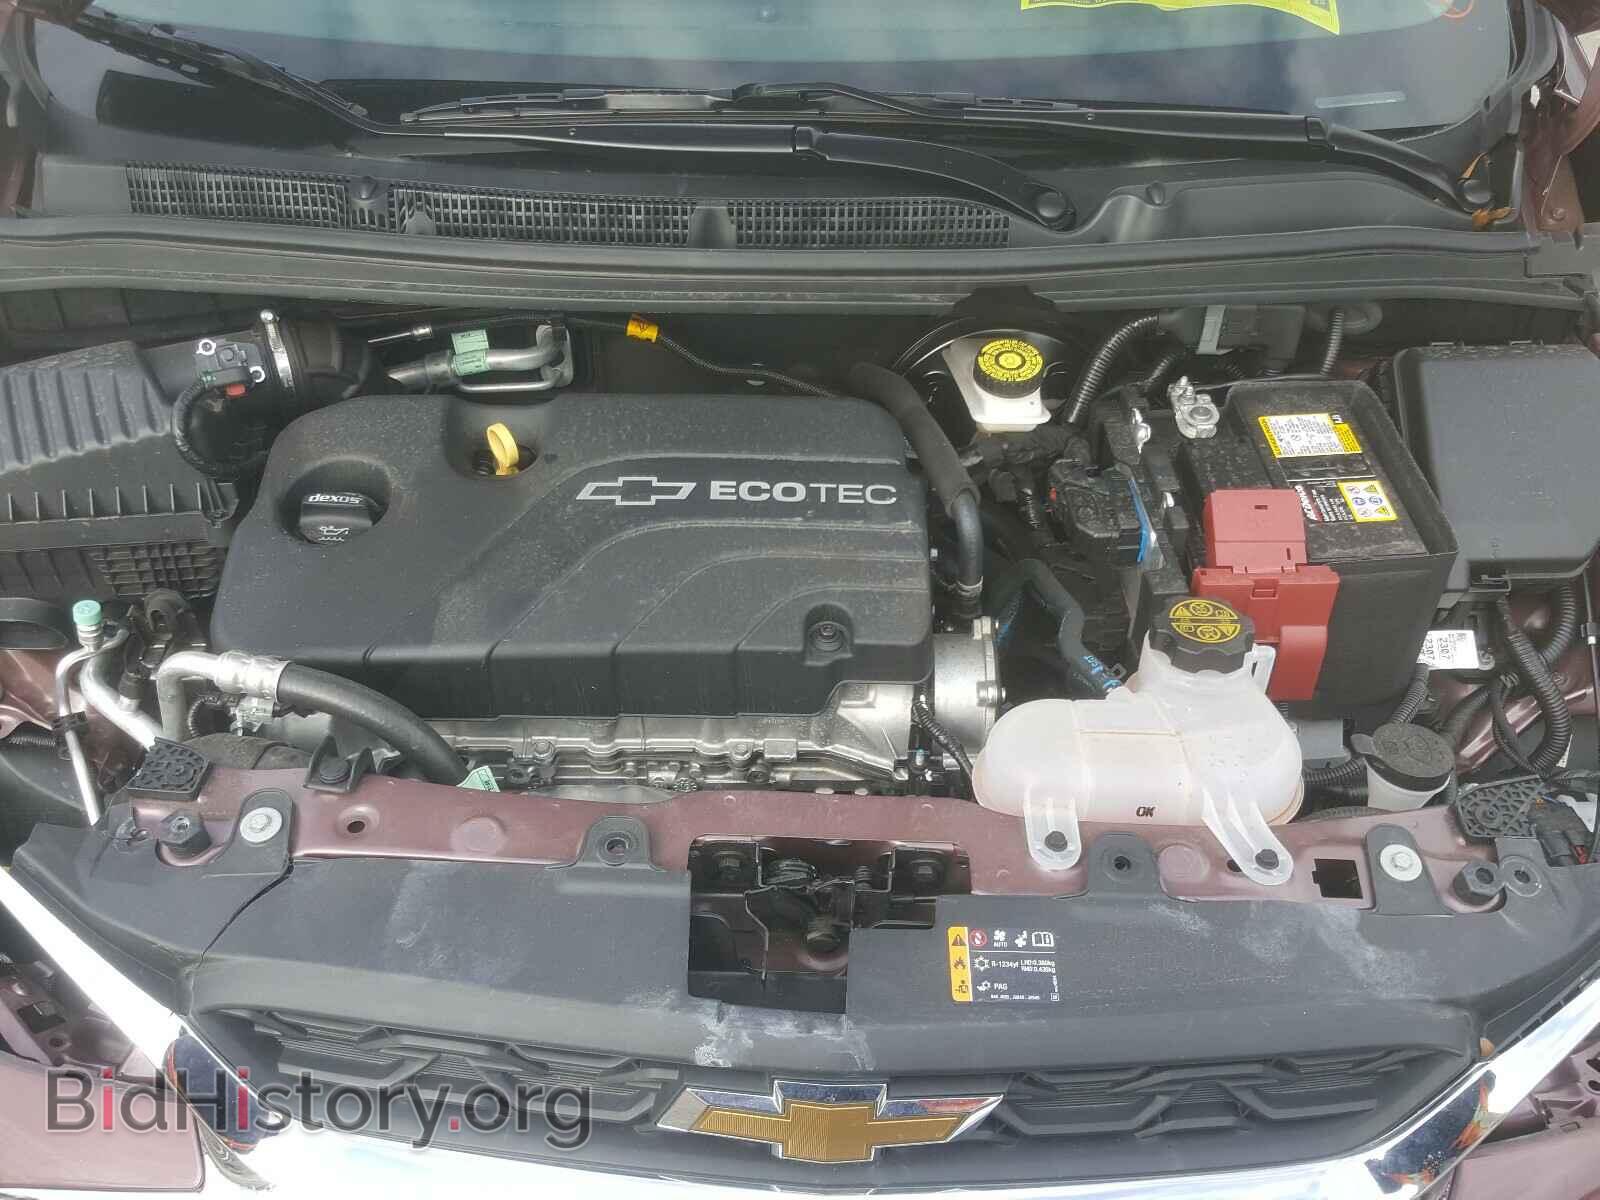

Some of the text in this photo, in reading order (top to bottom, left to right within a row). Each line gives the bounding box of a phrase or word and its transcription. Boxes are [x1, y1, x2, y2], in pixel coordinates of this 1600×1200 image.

[308, 493, 362, 504] dexos
[710, 481, 897, 505] ECOTEC
[1135, 806, 1156, 818] OK
[993, 982, 1008, 991] PAG
